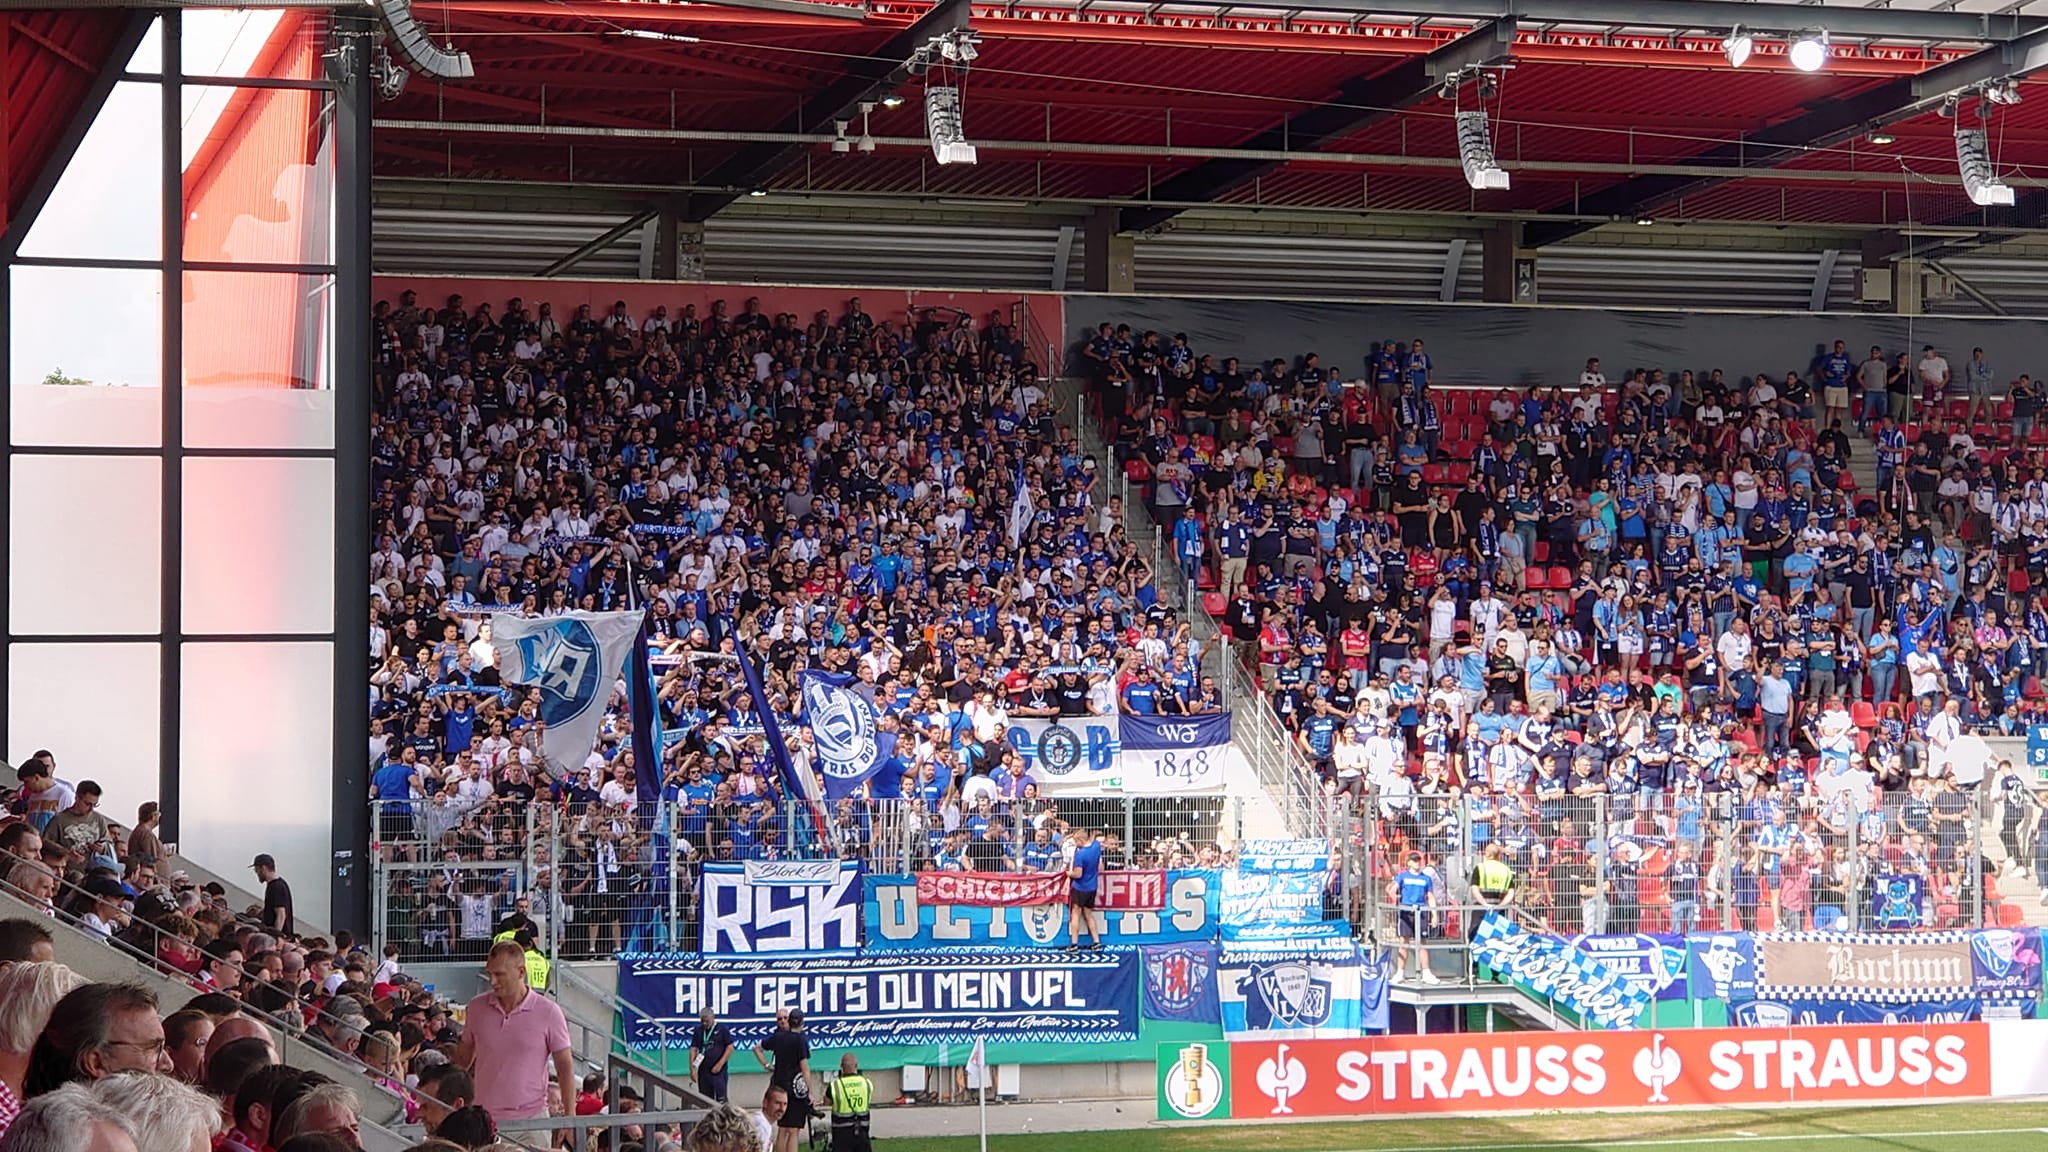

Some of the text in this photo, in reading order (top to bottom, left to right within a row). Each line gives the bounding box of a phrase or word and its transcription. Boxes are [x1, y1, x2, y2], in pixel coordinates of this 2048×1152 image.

[1519, 281, 1531, 297] 2
[821, 758, 857, 776] TRAS
[1154, 750, 1209, 784] 1848
[753, 863, 804, 879] Block
[702, 870, 857, 953] RSK
[701, 960, 731, 971] Nur
[771, 959, 803, 972] einig
[805, 958, 850, 968] müssen
[852, 957, 873, 967] wir
[874, 956, 900, 966] sein
[1827, 944, 1962, 986] Bochum
[676, 969, 1086, 1014] AUF GEHTS DU MEIN VFL
[1261, 976, 1295, 1018] VfL
[871, 1019, 898, 1032] und
[892, 1018, 953, 1034] geschlossen
[996, 1017, 1021, 1029] und
[1336, 1043, 1607, 1101] STRAUSS
[1709, 1035, 1968, 1093] STRAUSS
